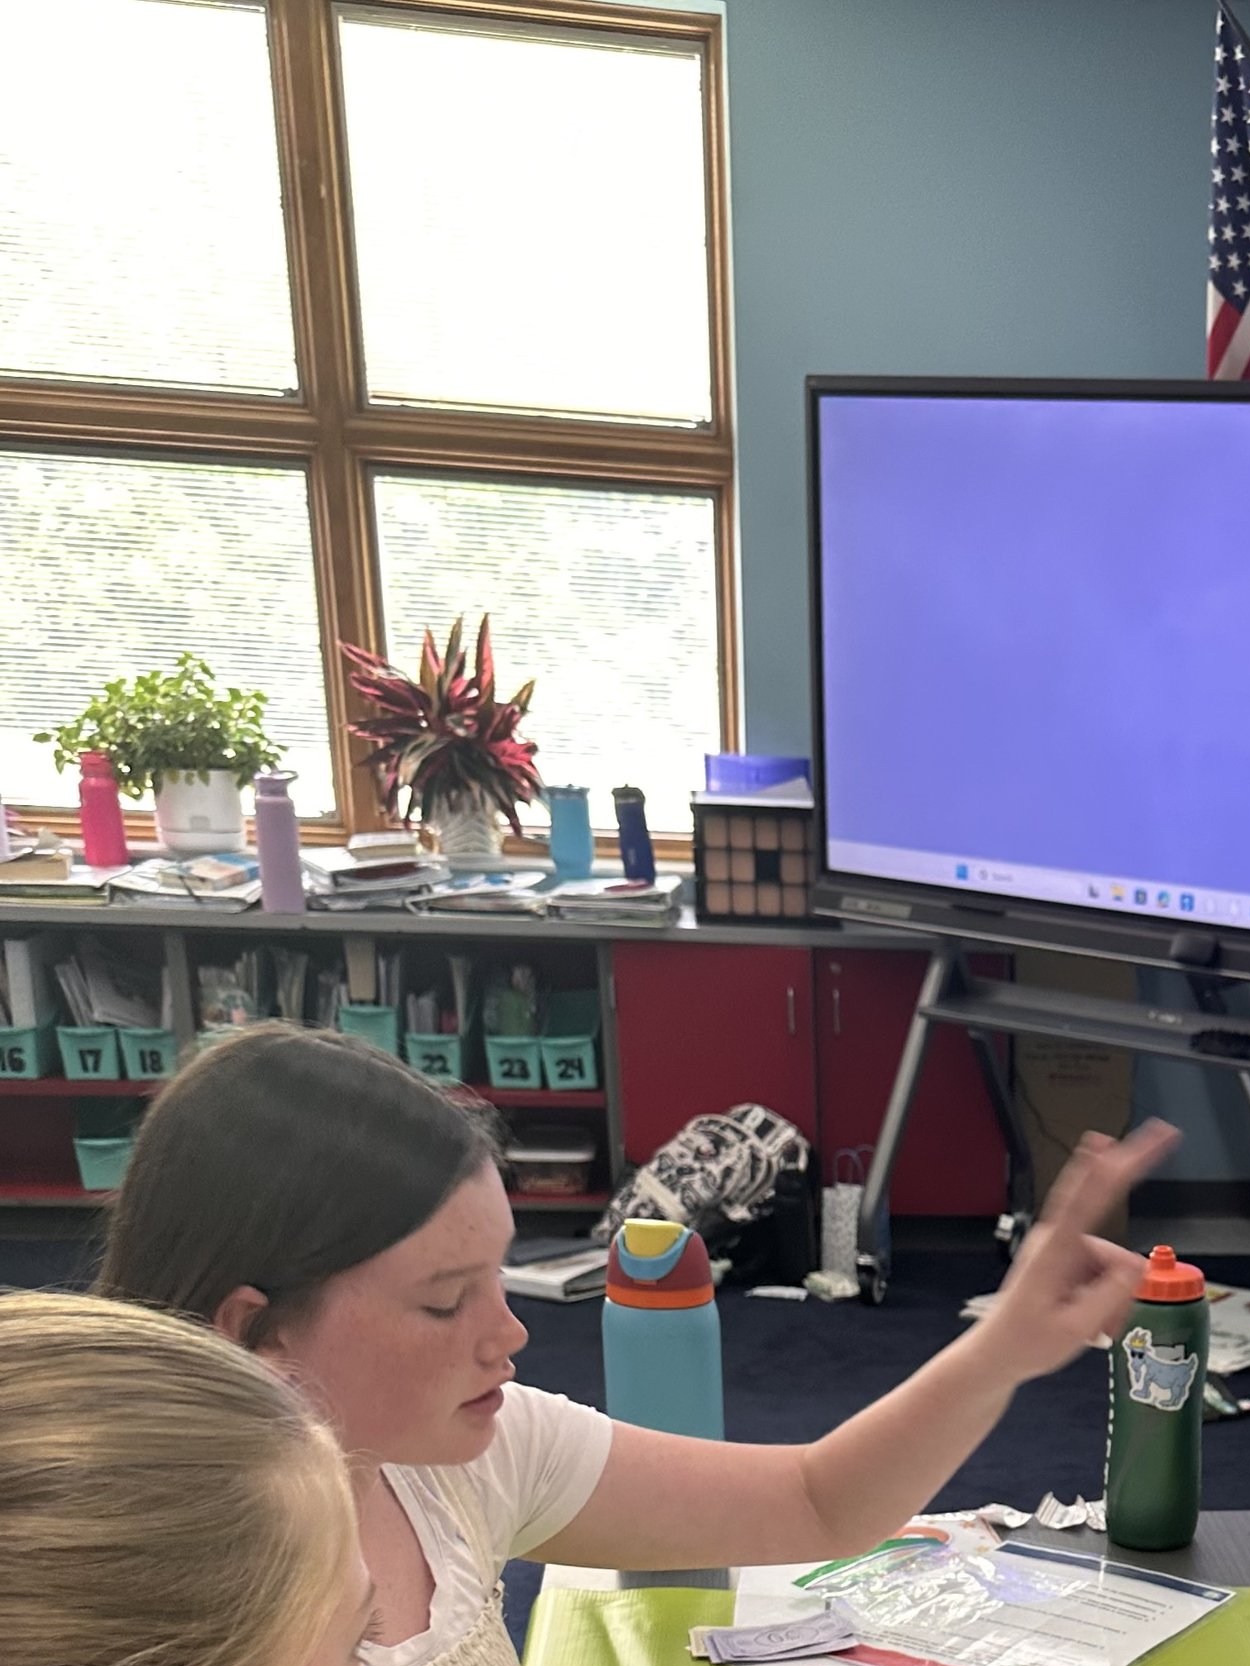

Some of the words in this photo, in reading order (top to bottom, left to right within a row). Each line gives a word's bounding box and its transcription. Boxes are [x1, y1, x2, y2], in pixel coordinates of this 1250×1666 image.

[1, 1047, 27, 1073] 16
[78, 1049, 101, 1073] 17
[138, 1050, 164, 1073] 18
[420, 1054, 451, 1074] 22
[498, 1058, 531, 1080] 23
[555, 1057, 586, 1081] 24
